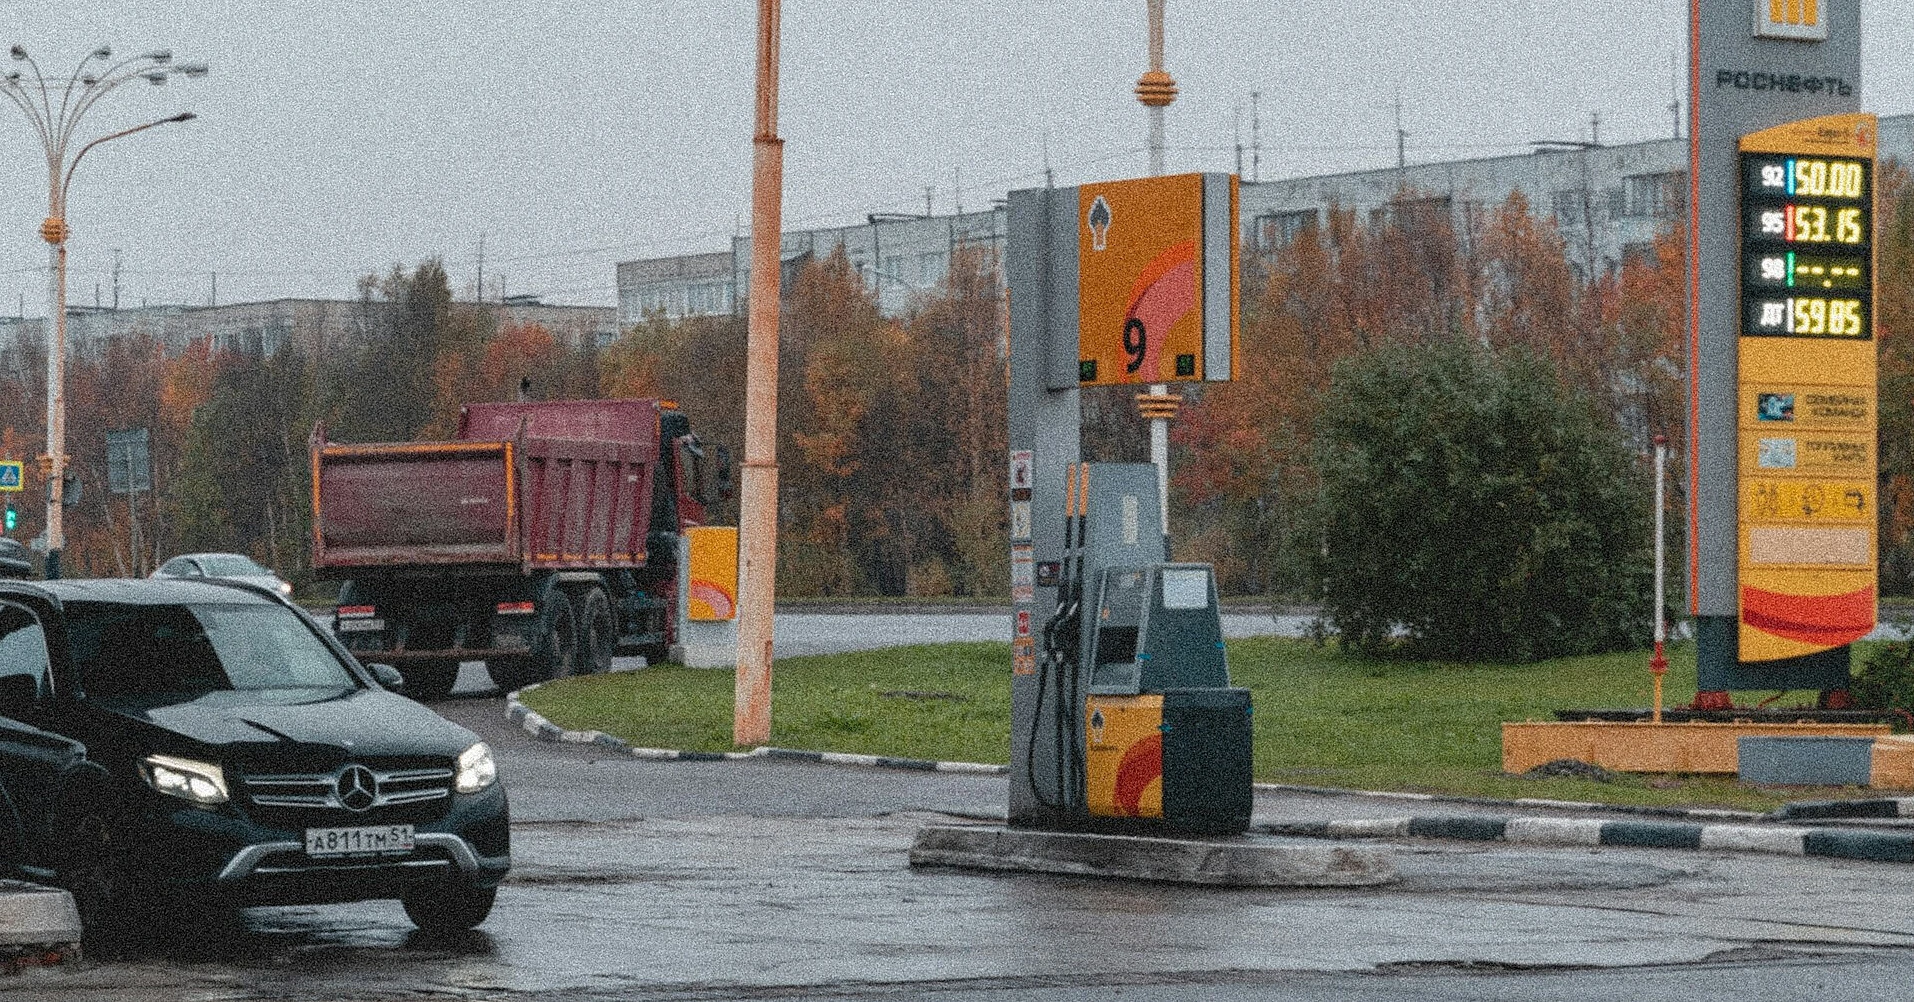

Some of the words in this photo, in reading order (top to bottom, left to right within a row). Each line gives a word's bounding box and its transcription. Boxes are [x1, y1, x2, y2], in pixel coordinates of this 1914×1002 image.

[1716, 69, 1852, 97] РОСНЕФТЬ
[1761, 165, 1785, 187] 92
[1761, 211, 1785, 234] 95
[1796, 205, 1862, 244] 53.15
[1123, 318, 1147, 374] 9
